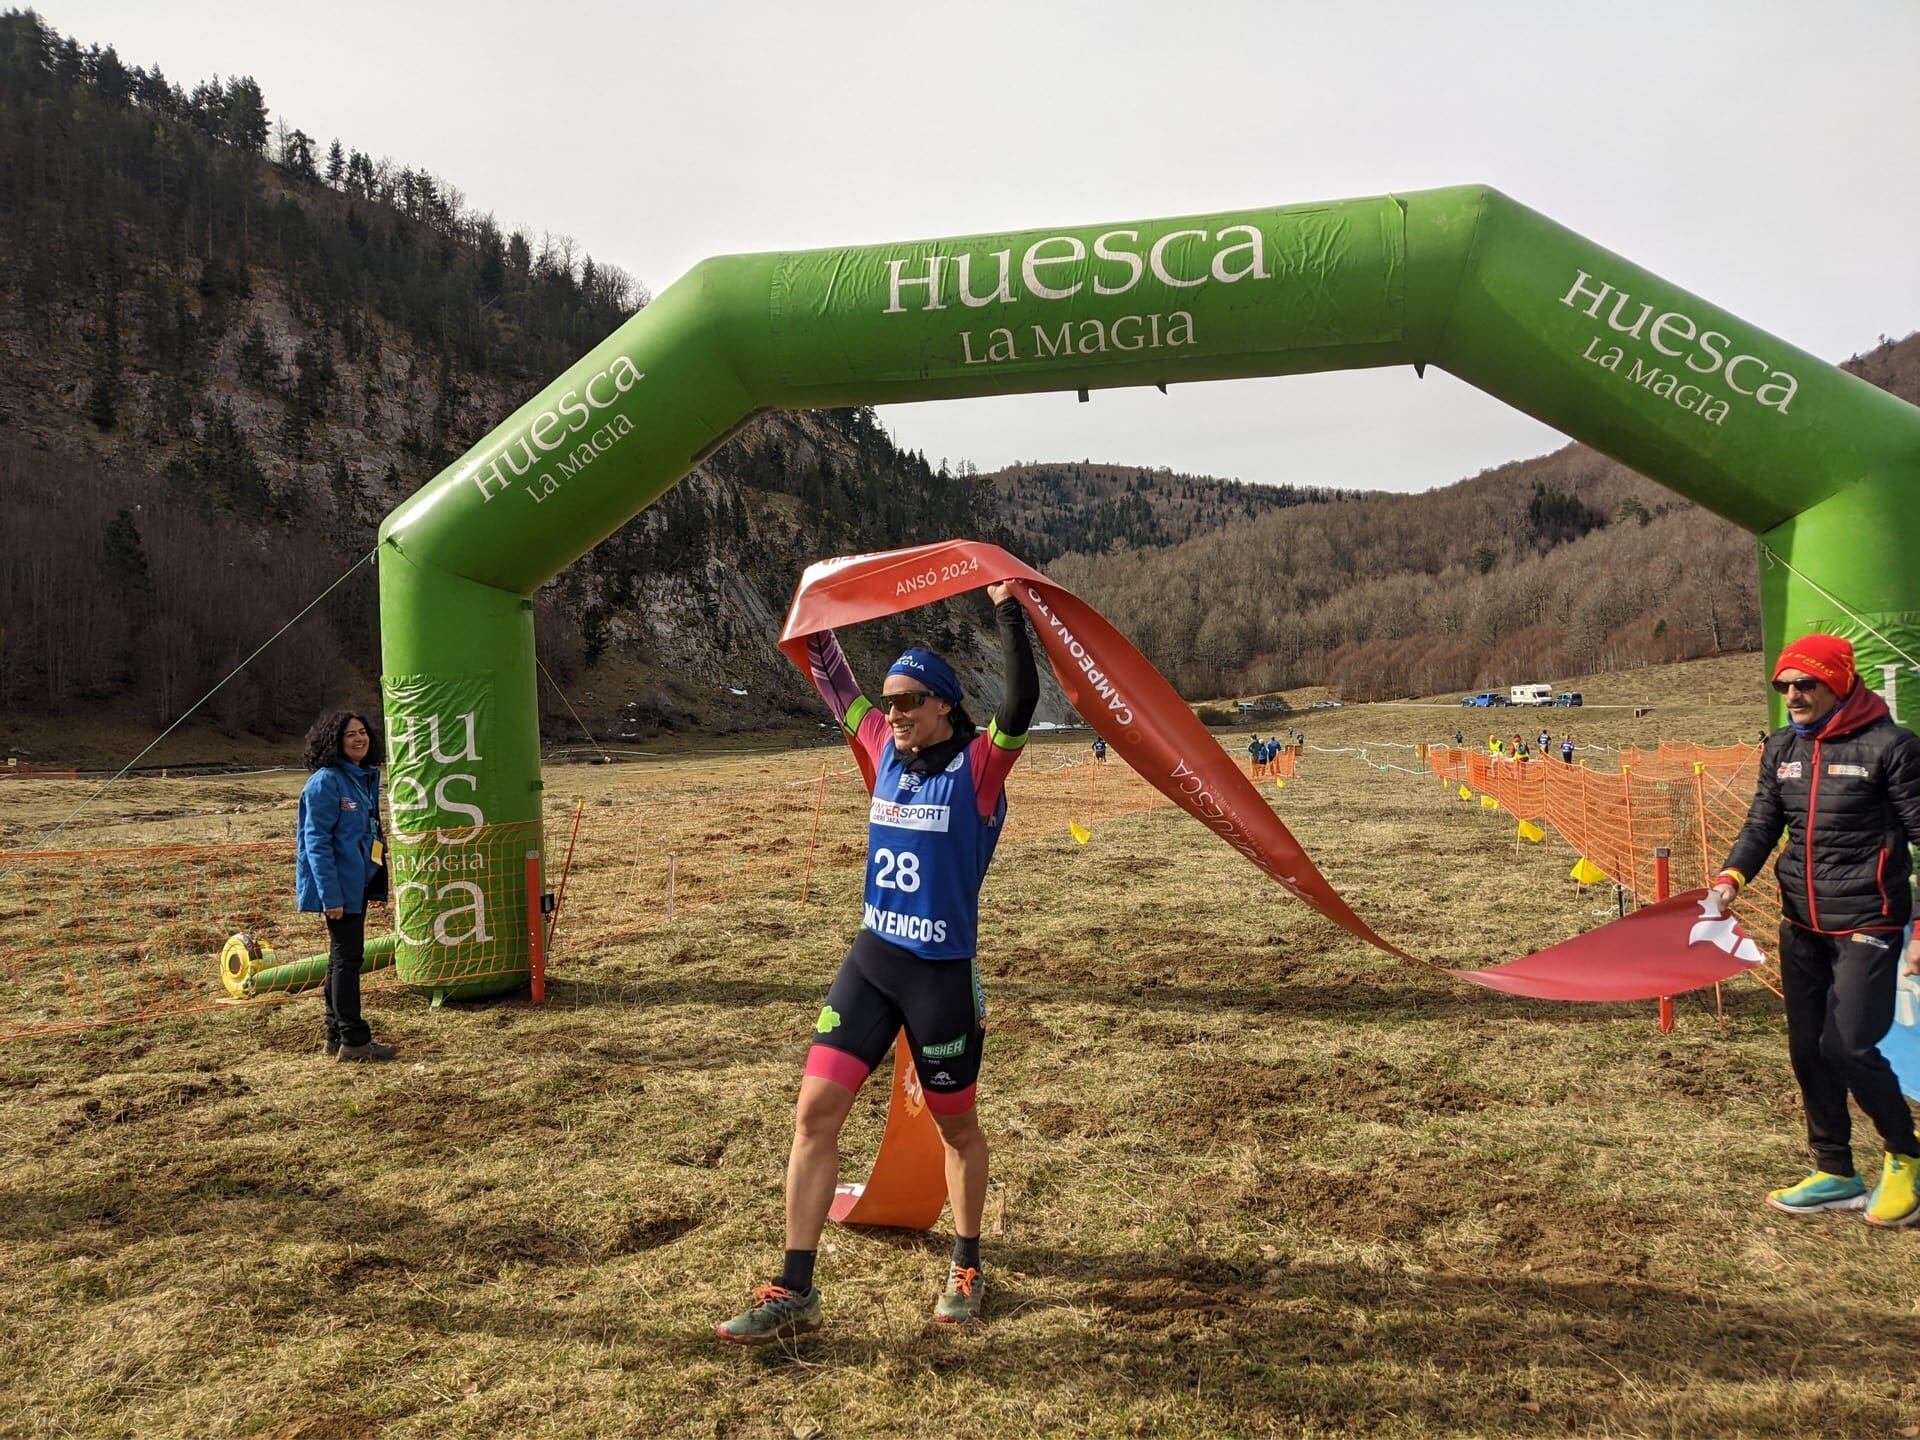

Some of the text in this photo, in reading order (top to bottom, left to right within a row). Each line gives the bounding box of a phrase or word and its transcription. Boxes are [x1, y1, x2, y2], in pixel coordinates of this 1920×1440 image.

[882, 224, 1272, 314] Huesca
[959, 327, 1020, 365] La
[1558, 268, 1799, 415] Huesca
[1581, 335, 1625, 373] La
[470, 355, 646, 504] Huesca
[525, 473, 561, 504] La
[895, 556, 979, 597] ANSÓ 2024
[1028, 587, 1134, 726] CAMPEONATO
[874, 848, 921, 893] 28
[863, 902, 947, 943] MAYENCOS
